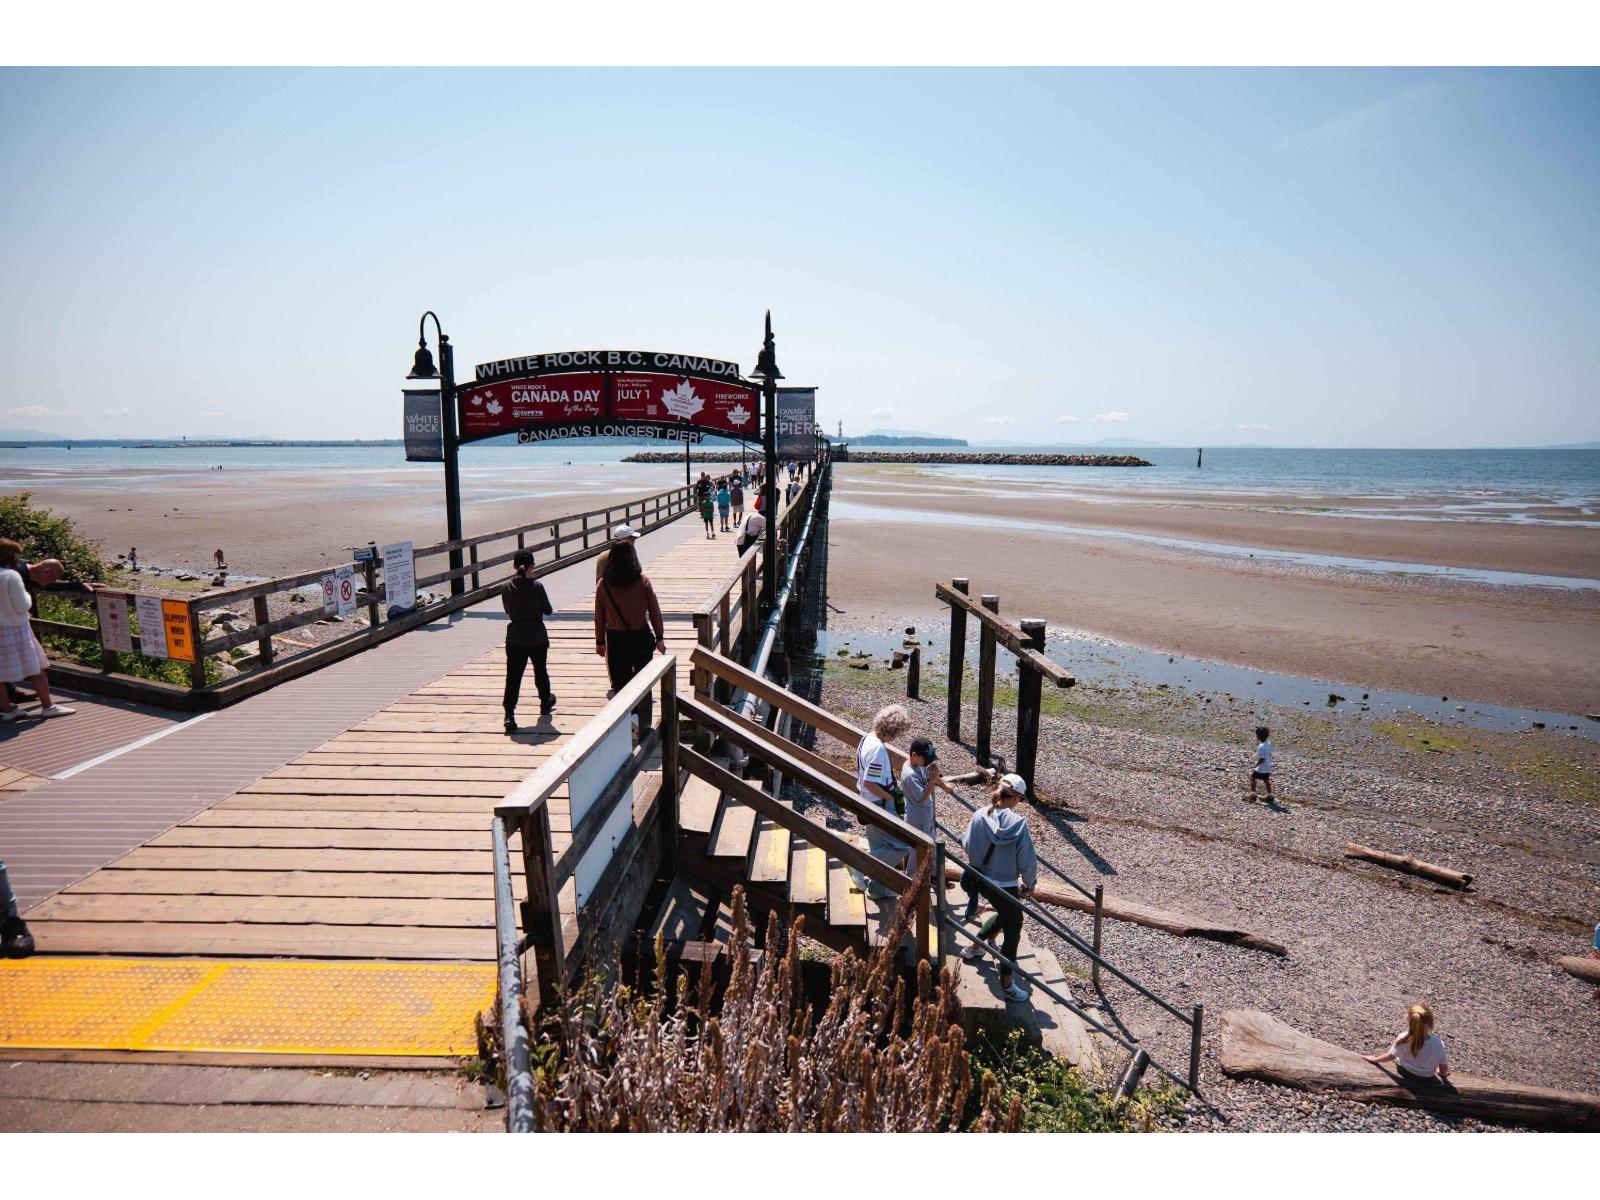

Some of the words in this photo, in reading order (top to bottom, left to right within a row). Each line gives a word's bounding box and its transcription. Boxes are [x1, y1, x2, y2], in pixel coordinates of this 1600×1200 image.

[476, 355, 540, 378] WHITE
[544, 351, 602, 368] ROCK
[607, 351, 647, 365] B.C.
[654, 353, 738, 378] CANADA
[511, 390, 569, 403] CANADA
[573, 389, 600, 403] DAY
[617, 389, 642, 402] JULY
[644, 389, 650, 400] 1
[406, 413, 440, 424] WHITE
[779, 414, 813, 422] LONGEST
[409, 423, 438, 433] ROCK
[518, 425, 591, 443] CANADA'S
[595, 424, 664, 438] LONGEST
[666, 428, 699, 443] PIER
[779, 421, 813, 435] PIER
